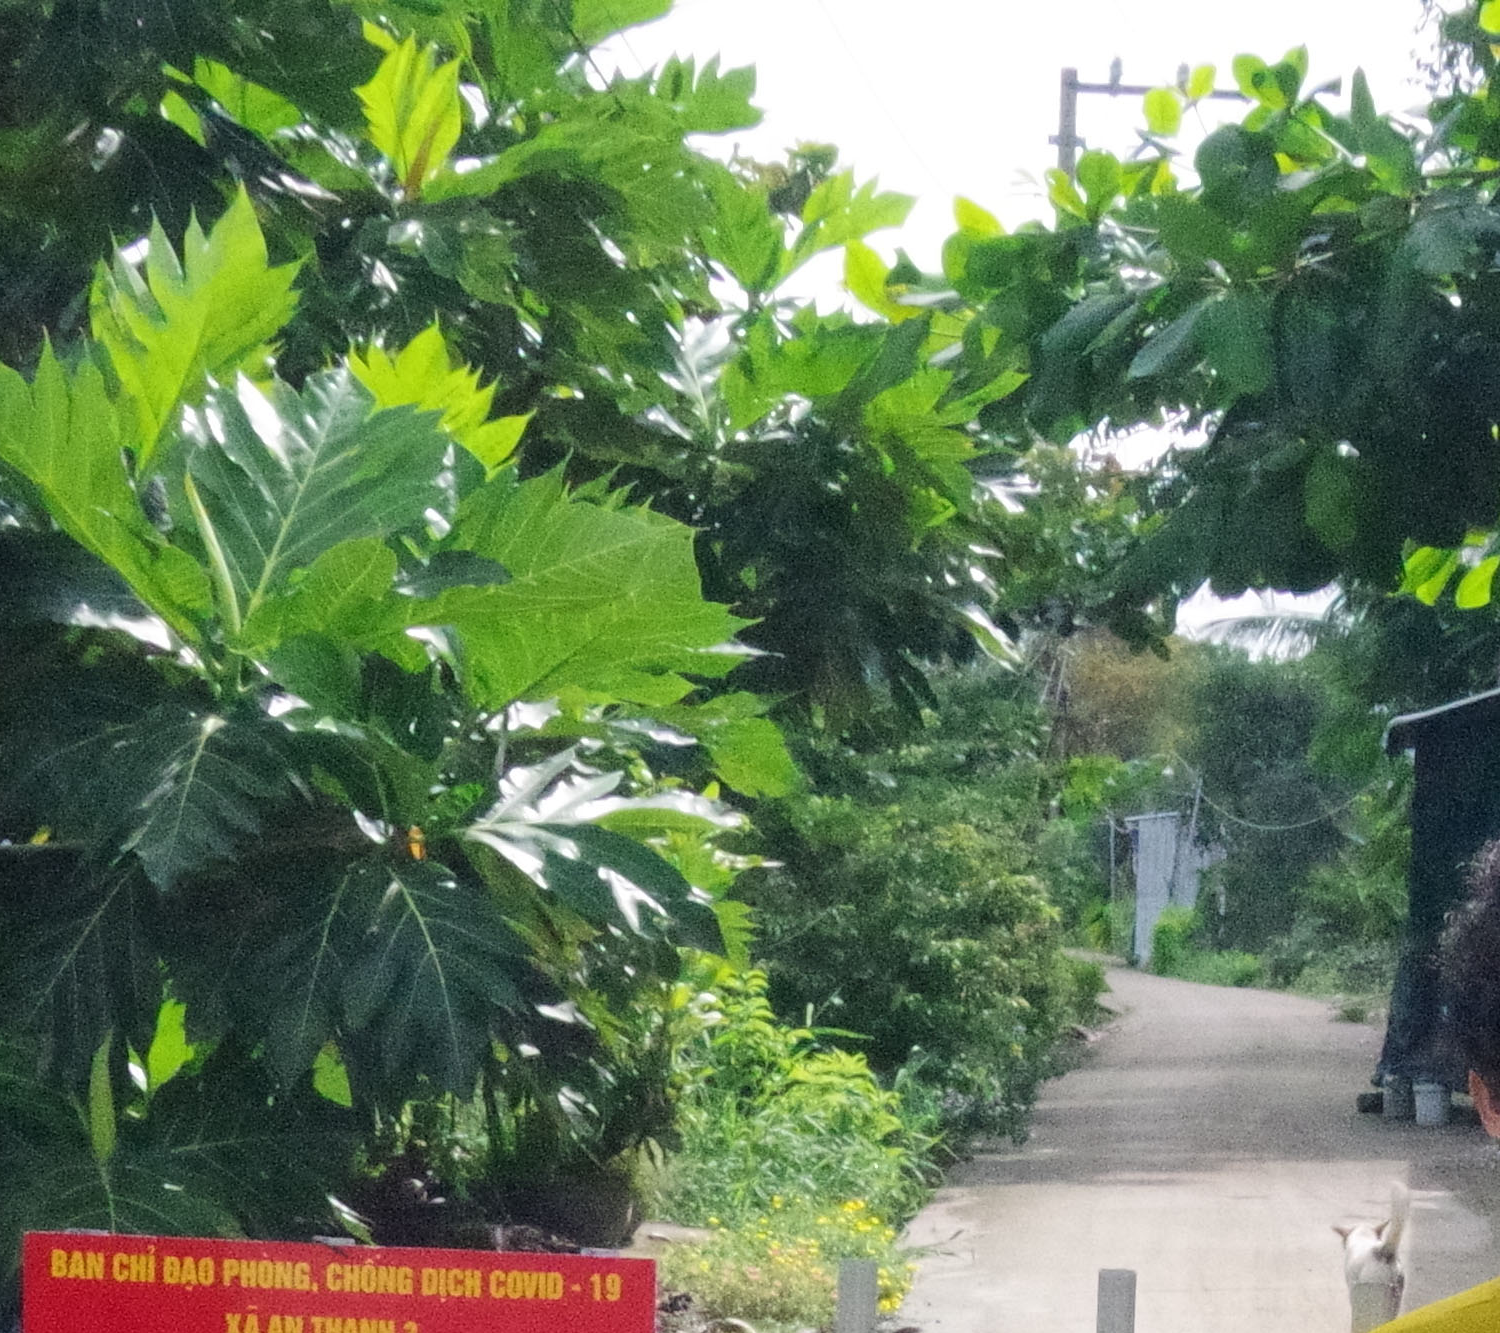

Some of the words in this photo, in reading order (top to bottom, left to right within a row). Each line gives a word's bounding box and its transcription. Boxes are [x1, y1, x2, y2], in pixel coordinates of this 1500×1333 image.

[50, 1249, 104, 1280] BAN
[112, 1245, 156, 1283] CHỈ
[163, 1255, 215, 1291] ĐẠO
[421, 1268, 482, 1303] DỊCH
[489, 1270, 564, 1301] COVID
[590, 1273, 621, 1301] 19
